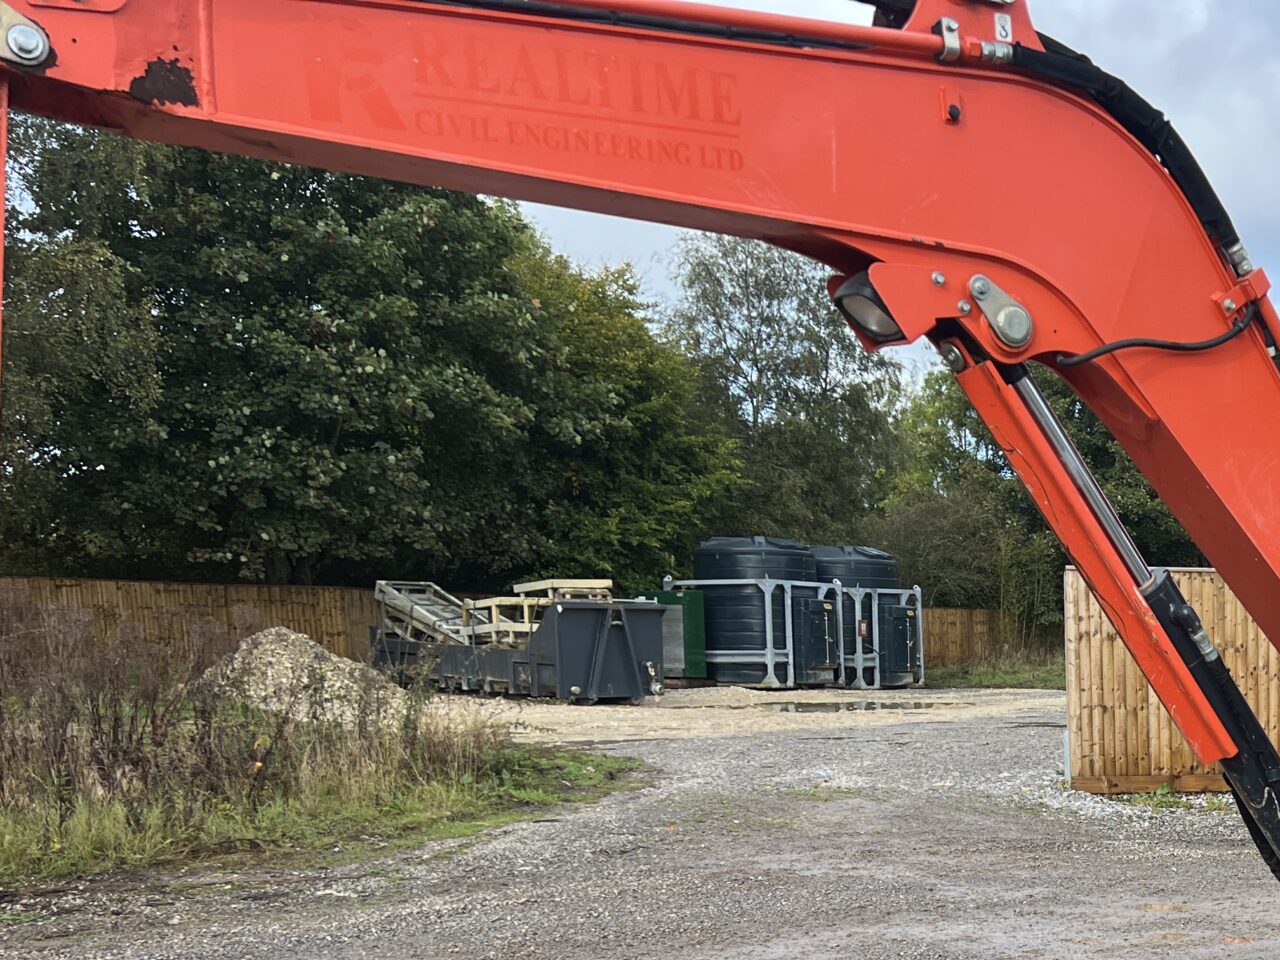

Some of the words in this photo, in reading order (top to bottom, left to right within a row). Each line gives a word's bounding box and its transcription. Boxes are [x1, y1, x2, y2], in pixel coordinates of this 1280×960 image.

[413, 25, 744, 127] REALTIME
[414, 109, 499, 144] CIVIL
[507, 118, 692, 166] ENGINEERING
[699, 144, 745, 173] LTD
